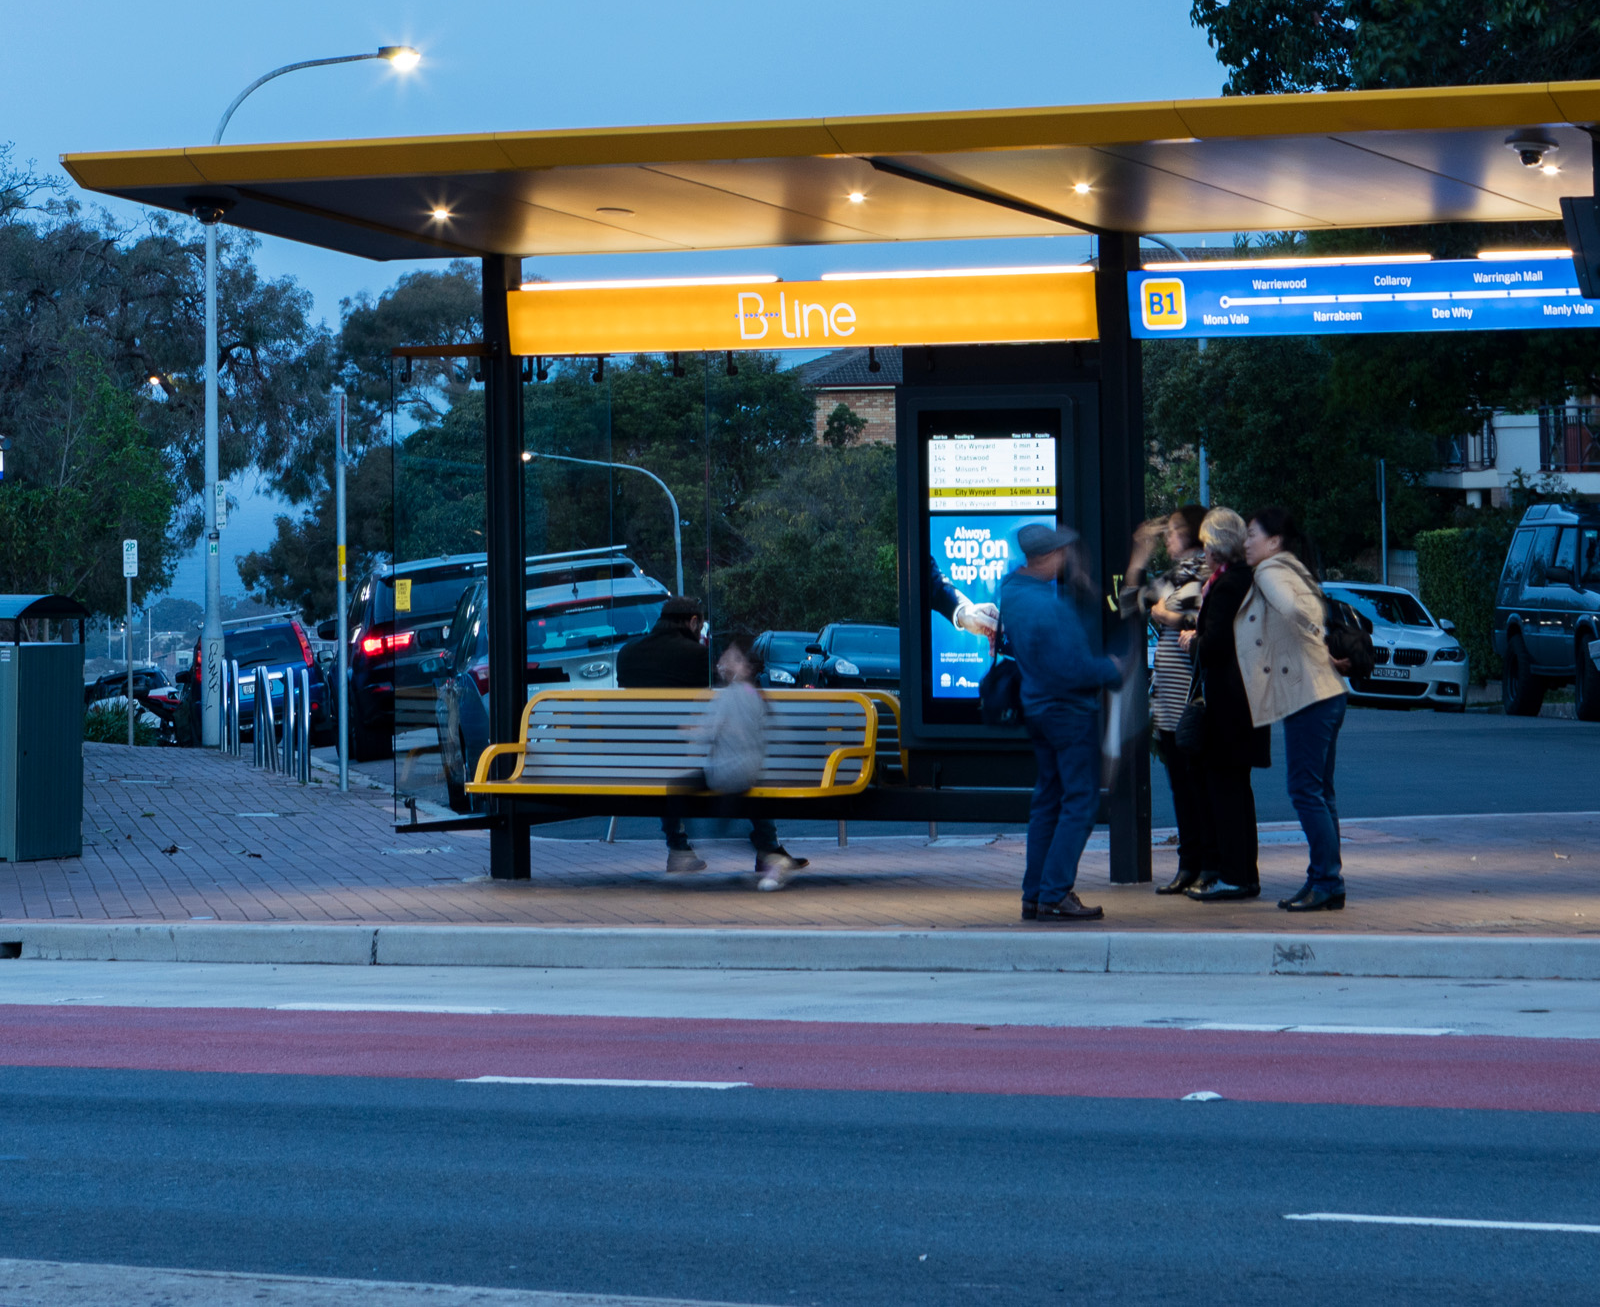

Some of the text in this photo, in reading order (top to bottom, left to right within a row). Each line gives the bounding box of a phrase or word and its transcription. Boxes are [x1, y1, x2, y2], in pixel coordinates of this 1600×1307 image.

[1373, 275, 1412, 288] Collaroy
[1473, 270, 1543, 285] Warringah Mall
[1252, 278, 1307, 290] Warriewood
[1150, 291, 1178, 316] B1
[1313, 310, 1362, 322] Narrabeen
[1432, 307, 1473, 321] Dee Why
[1543, 303, 1594, 317] Manly Vale
[1203, 313, 1249, 325] Mona Vale
[955, 443, 967, 451] City
[969, 443, 996, 451] Wynyard
[955, 489, 967, 497] City
[968, 488, 997, 497] Wynyard
[969, 500, 996, 509] Wynyard
[954, 526, 991, 542] Always
[125, 542, 135, 552] 2P
[210, 544, 217, 553] H
[944, 536, 1008, 565] tap on
[972, 557, 986, 566] and
[950, 560, 1004, 585] tap off
